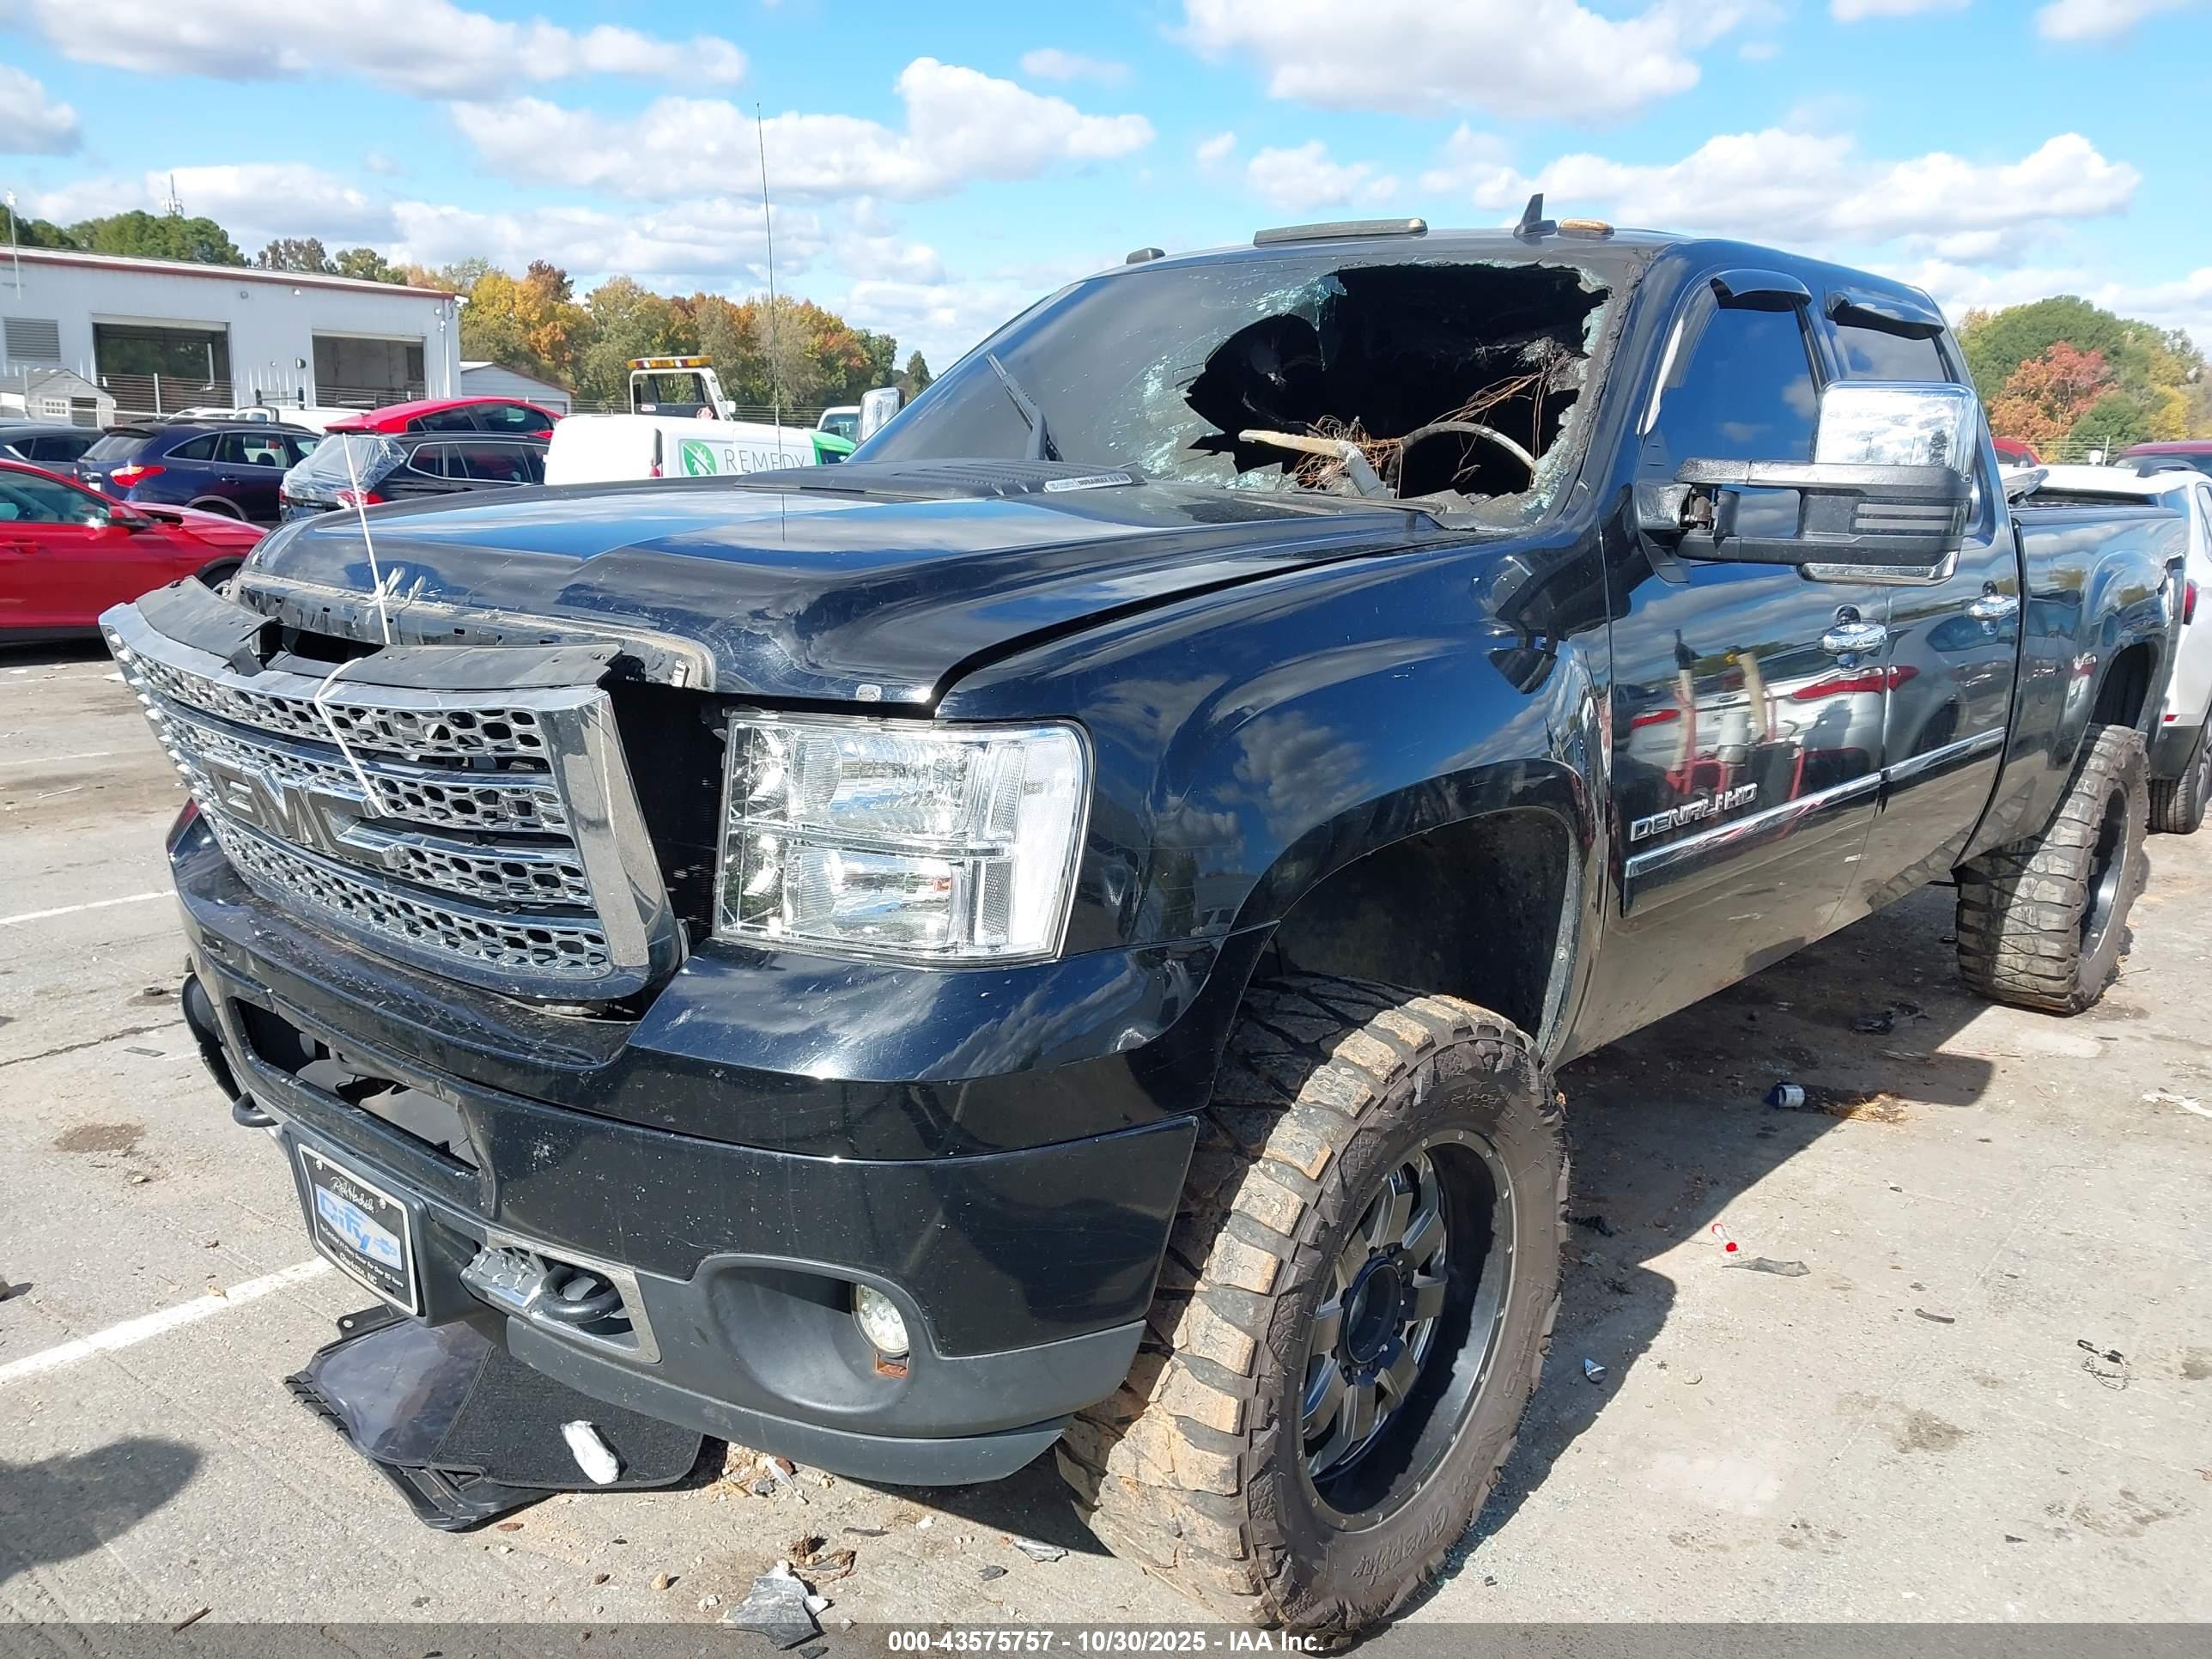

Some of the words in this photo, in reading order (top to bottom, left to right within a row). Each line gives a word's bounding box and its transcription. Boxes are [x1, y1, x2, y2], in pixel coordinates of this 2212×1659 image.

[724, 448, 805, 473] REMEDY
[201, 750, 410, 869] GMC
[1630, 793, 1724, 842] DENALI
[1723, 782, 1759, 811] HD
[367, 1271, 378, 1285] NC
